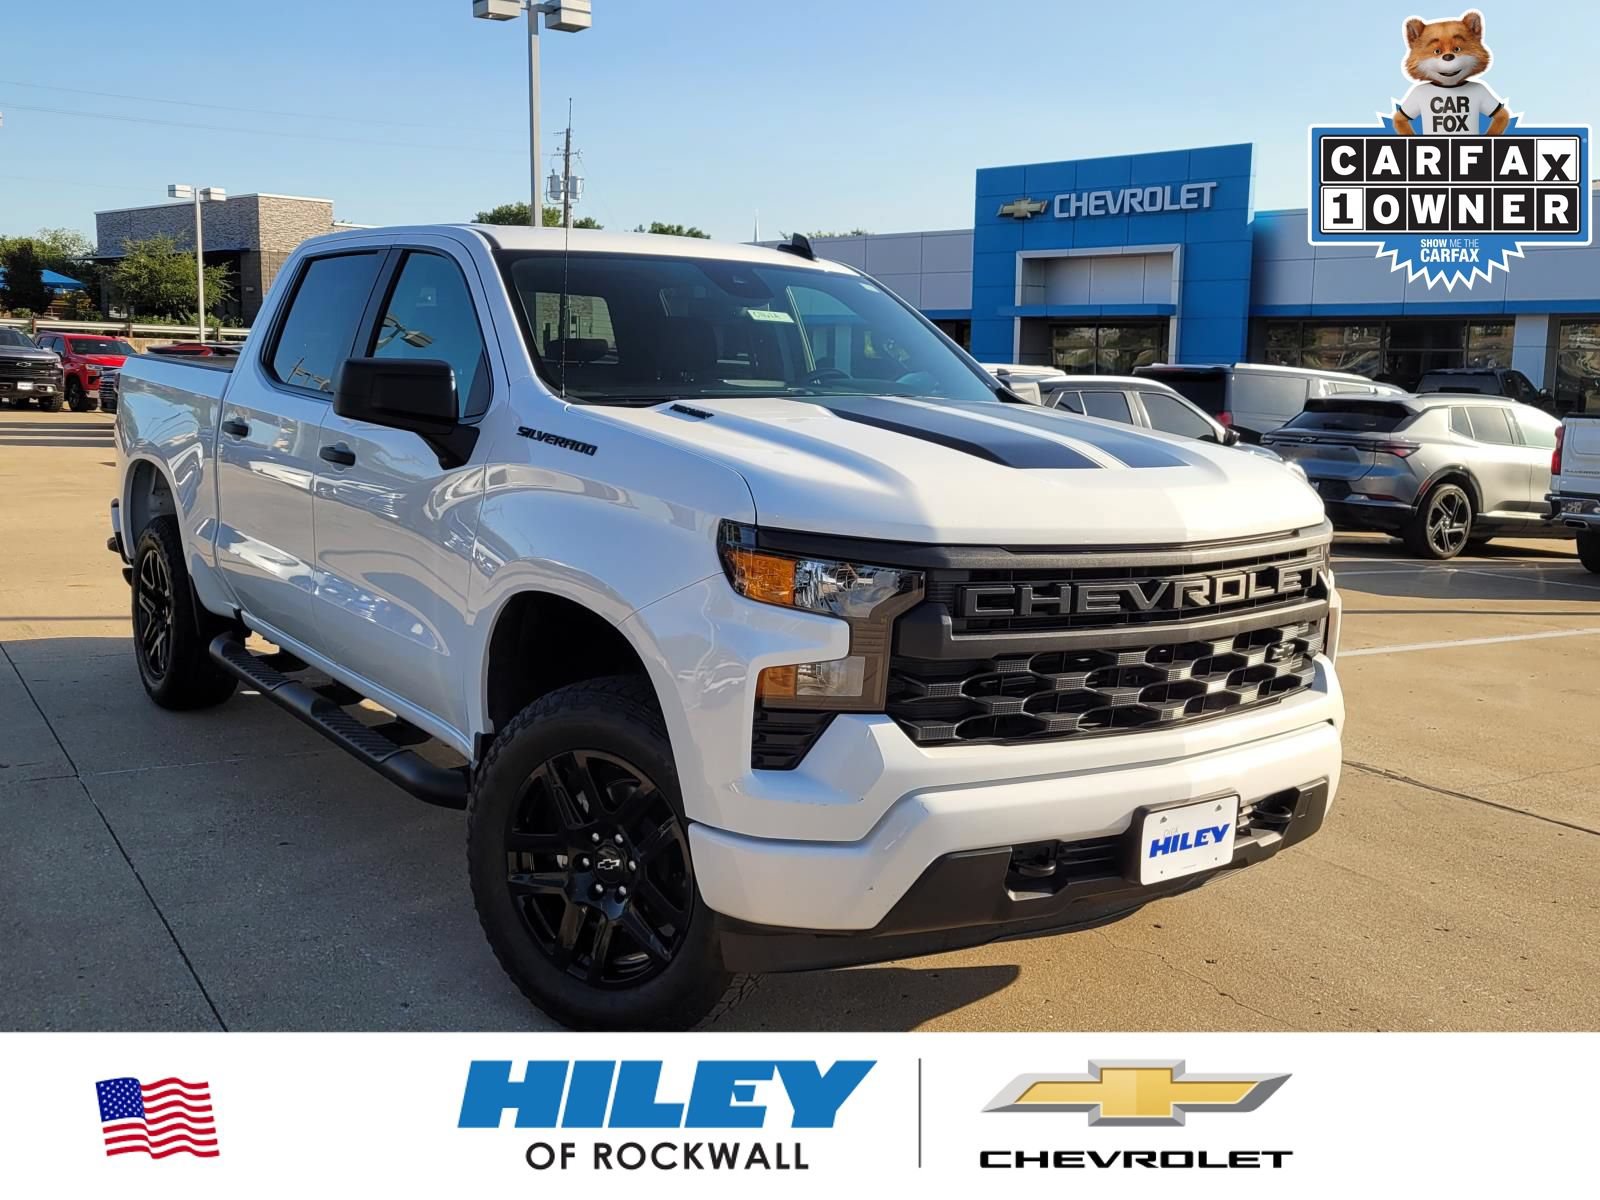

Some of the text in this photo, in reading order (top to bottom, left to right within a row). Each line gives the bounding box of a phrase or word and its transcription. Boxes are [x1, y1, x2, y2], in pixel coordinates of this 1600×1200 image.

[1054, 182, 1217, 218] CHEVROLET
[516, 425, 598, 456] SILVERADO
[961, 564, 1321, 616] CHEVROLET
[1149, 823, 1231, 859] HILEY
